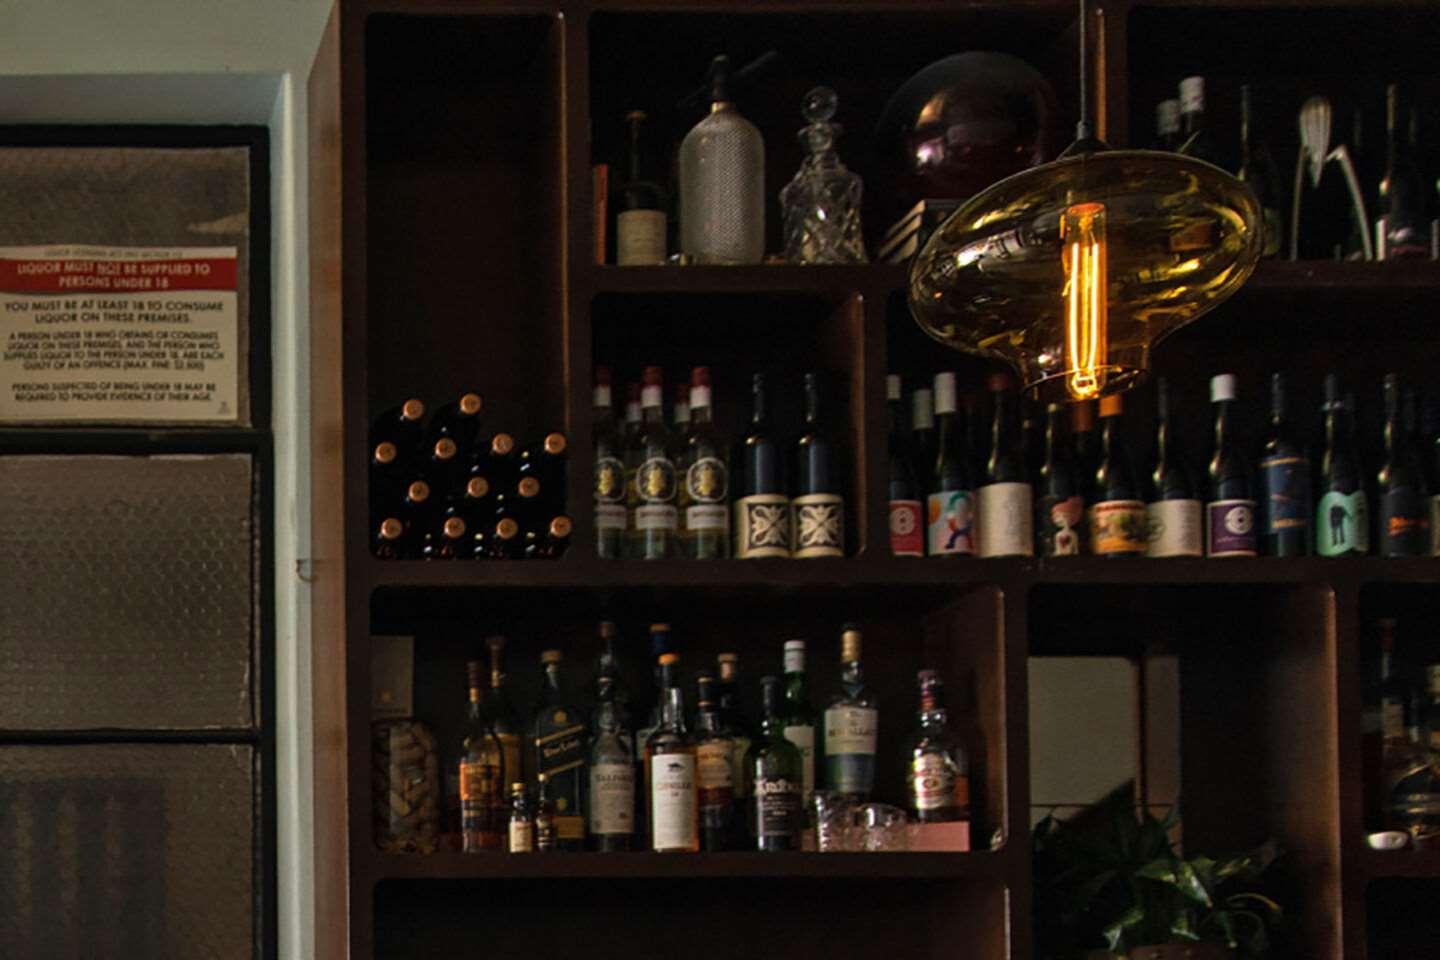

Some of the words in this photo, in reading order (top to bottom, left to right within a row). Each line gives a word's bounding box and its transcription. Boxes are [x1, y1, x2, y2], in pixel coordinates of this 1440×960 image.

[17, 263, 61, 274] LIQUOR
[64, 261, 95, 272] MUST
[124, 263, 138, 273] BE
[141, 263, 192, 274] SUPPLIED
[194, 263, 211, 274] TO
[59, 276, 112, 288] PERSONS
[113, 276, 152, 288] UNDER
[155, 276, 169, 288] 18
[4, 302, 29, 311] YOU
[32, 301, 61, 310] MUST
[64, 301, 77, 309] BE
[81, 300, 94, 309] AT
[98, 300, 129, 309] LEAST
[148, 301, 162, 310] TO
[165, 301, 224, 311] CONSUME
[34, 313, 78, 323] LIQUOR
[81, 313, 100, 321] ON
[103, 313, 135, 321] THESE
